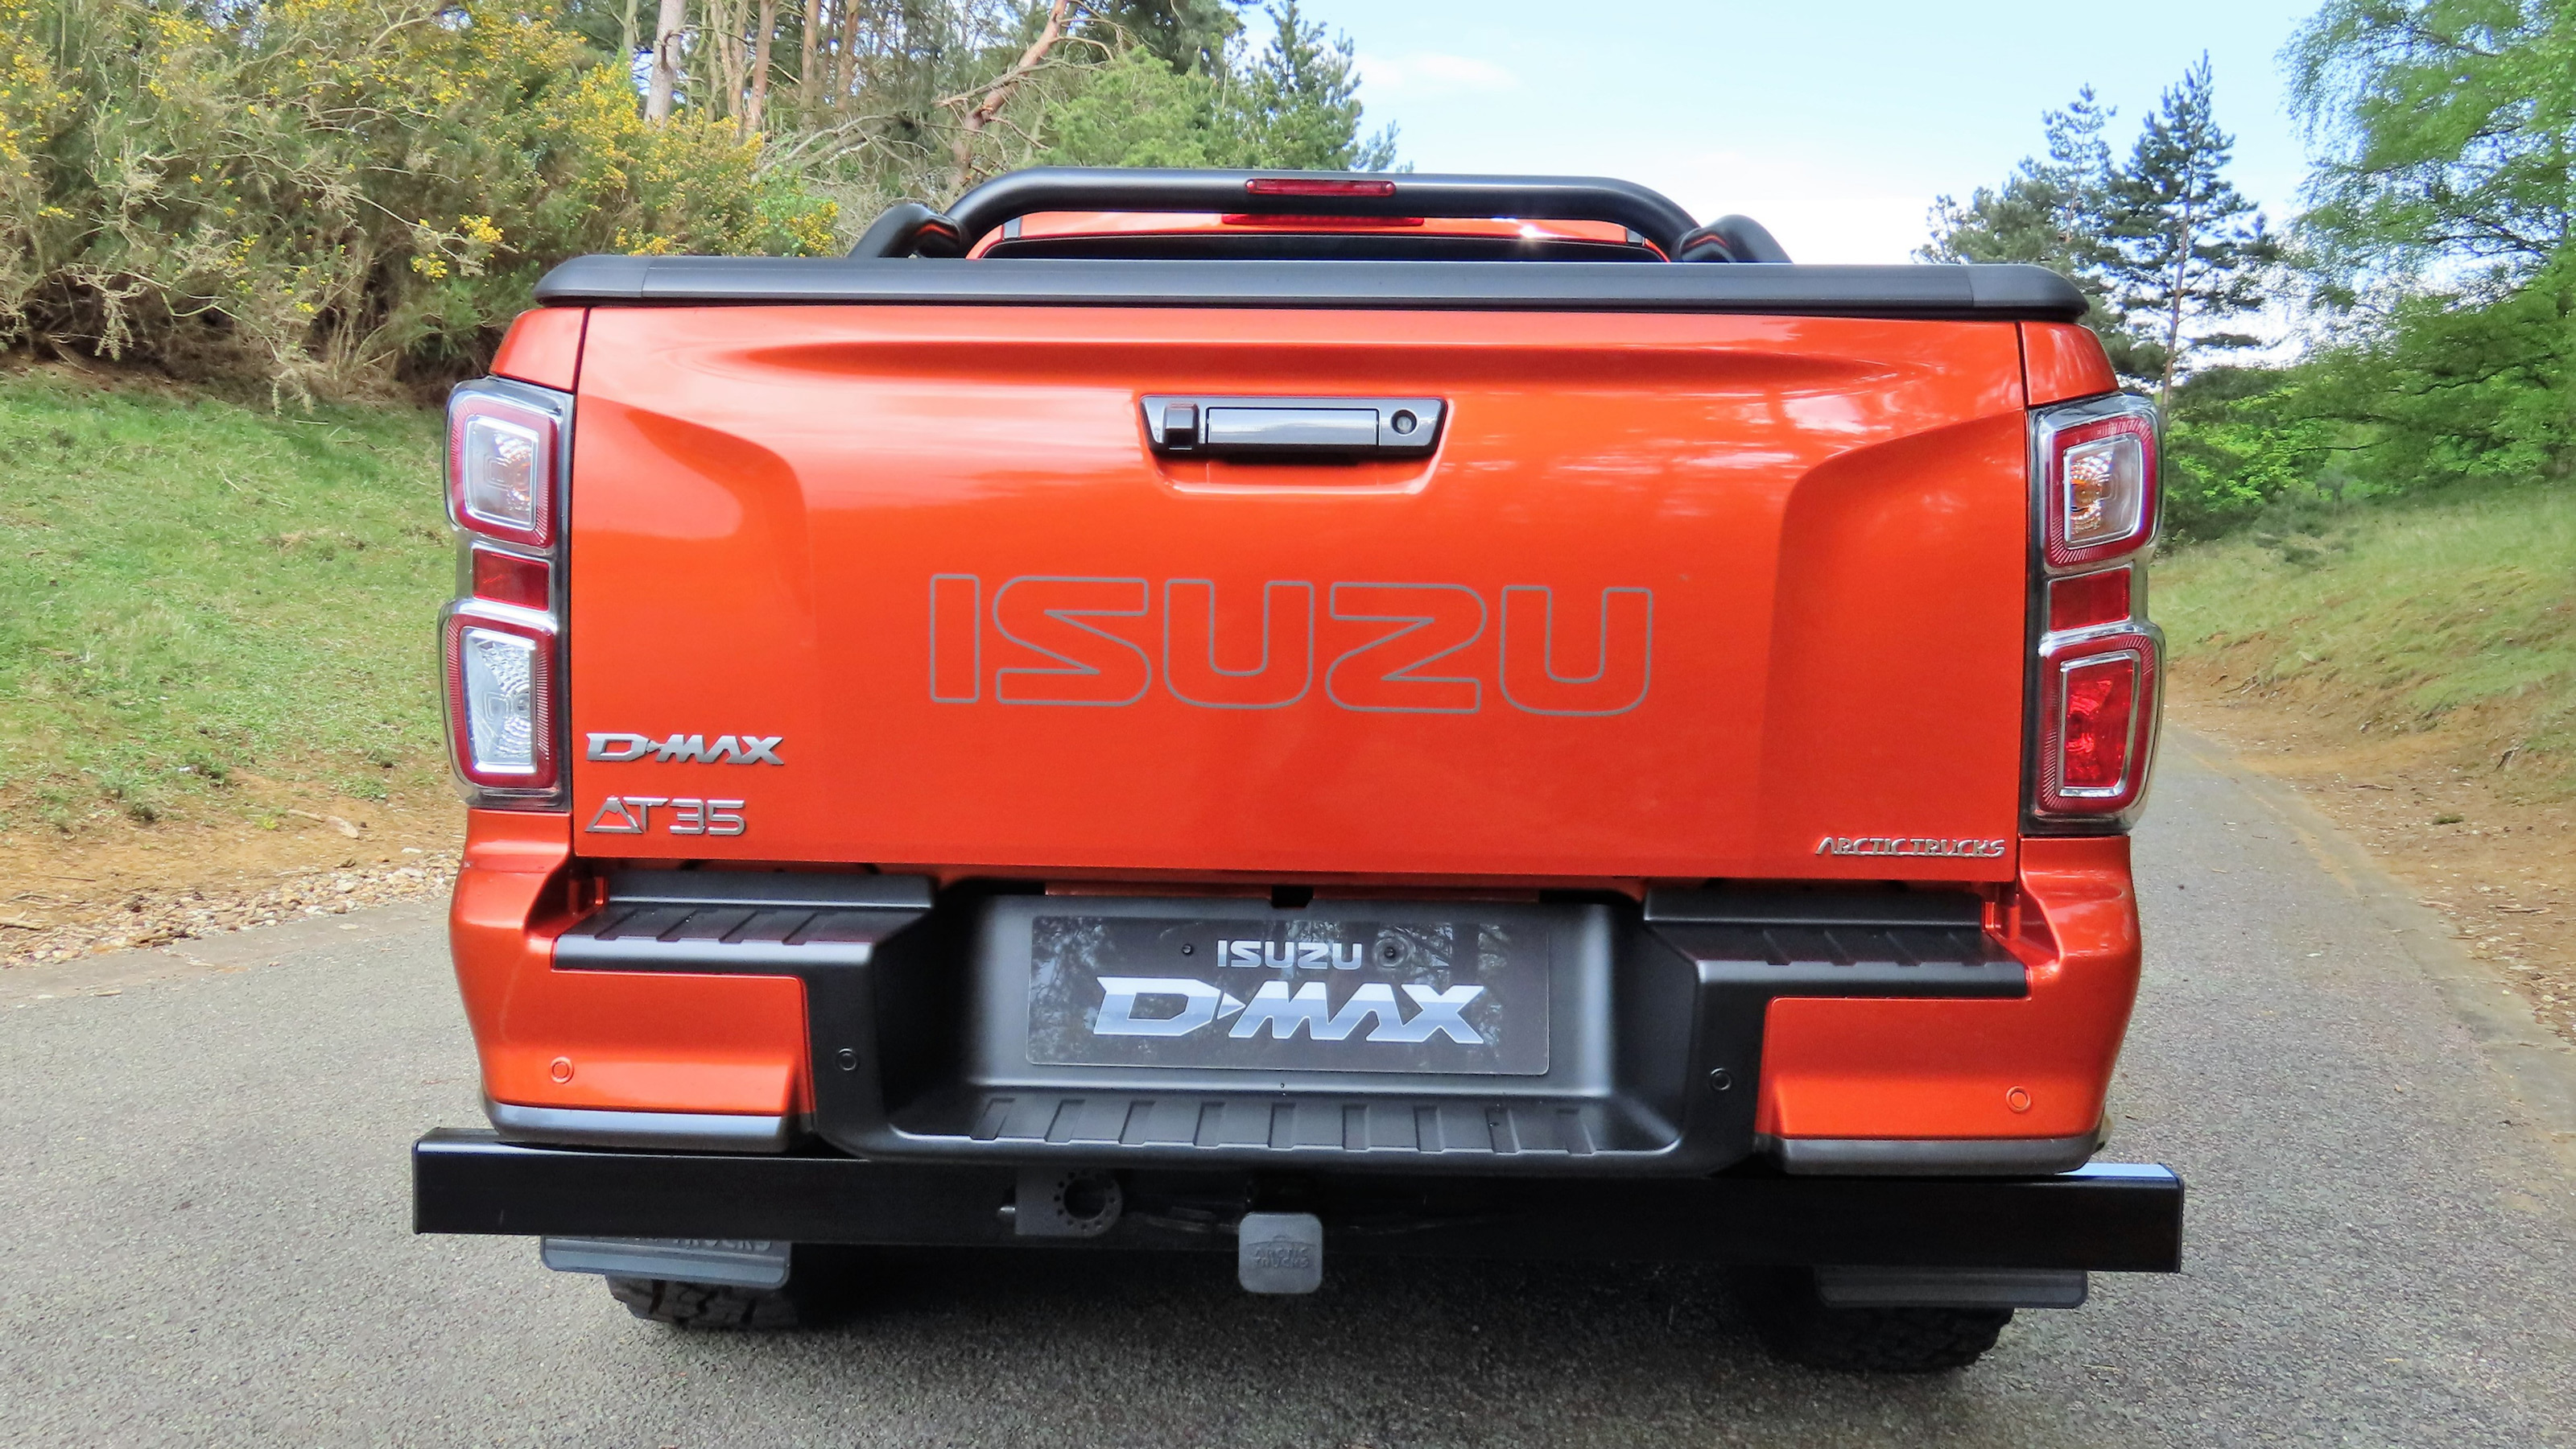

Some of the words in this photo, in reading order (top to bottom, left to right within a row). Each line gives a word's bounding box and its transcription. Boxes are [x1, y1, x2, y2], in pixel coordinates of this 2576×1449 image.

[931, 574, 1652, 716] ISUZU
[586, 733, 784, 765] D-MAX
[1815, 837, 1906, 856] ARCTIC
[1909, 839, 2005, 857] TRUCKS
[1217, 939, 1362, 970] ISUZU
[1093, 976, 1484, 1044] D-MAX
